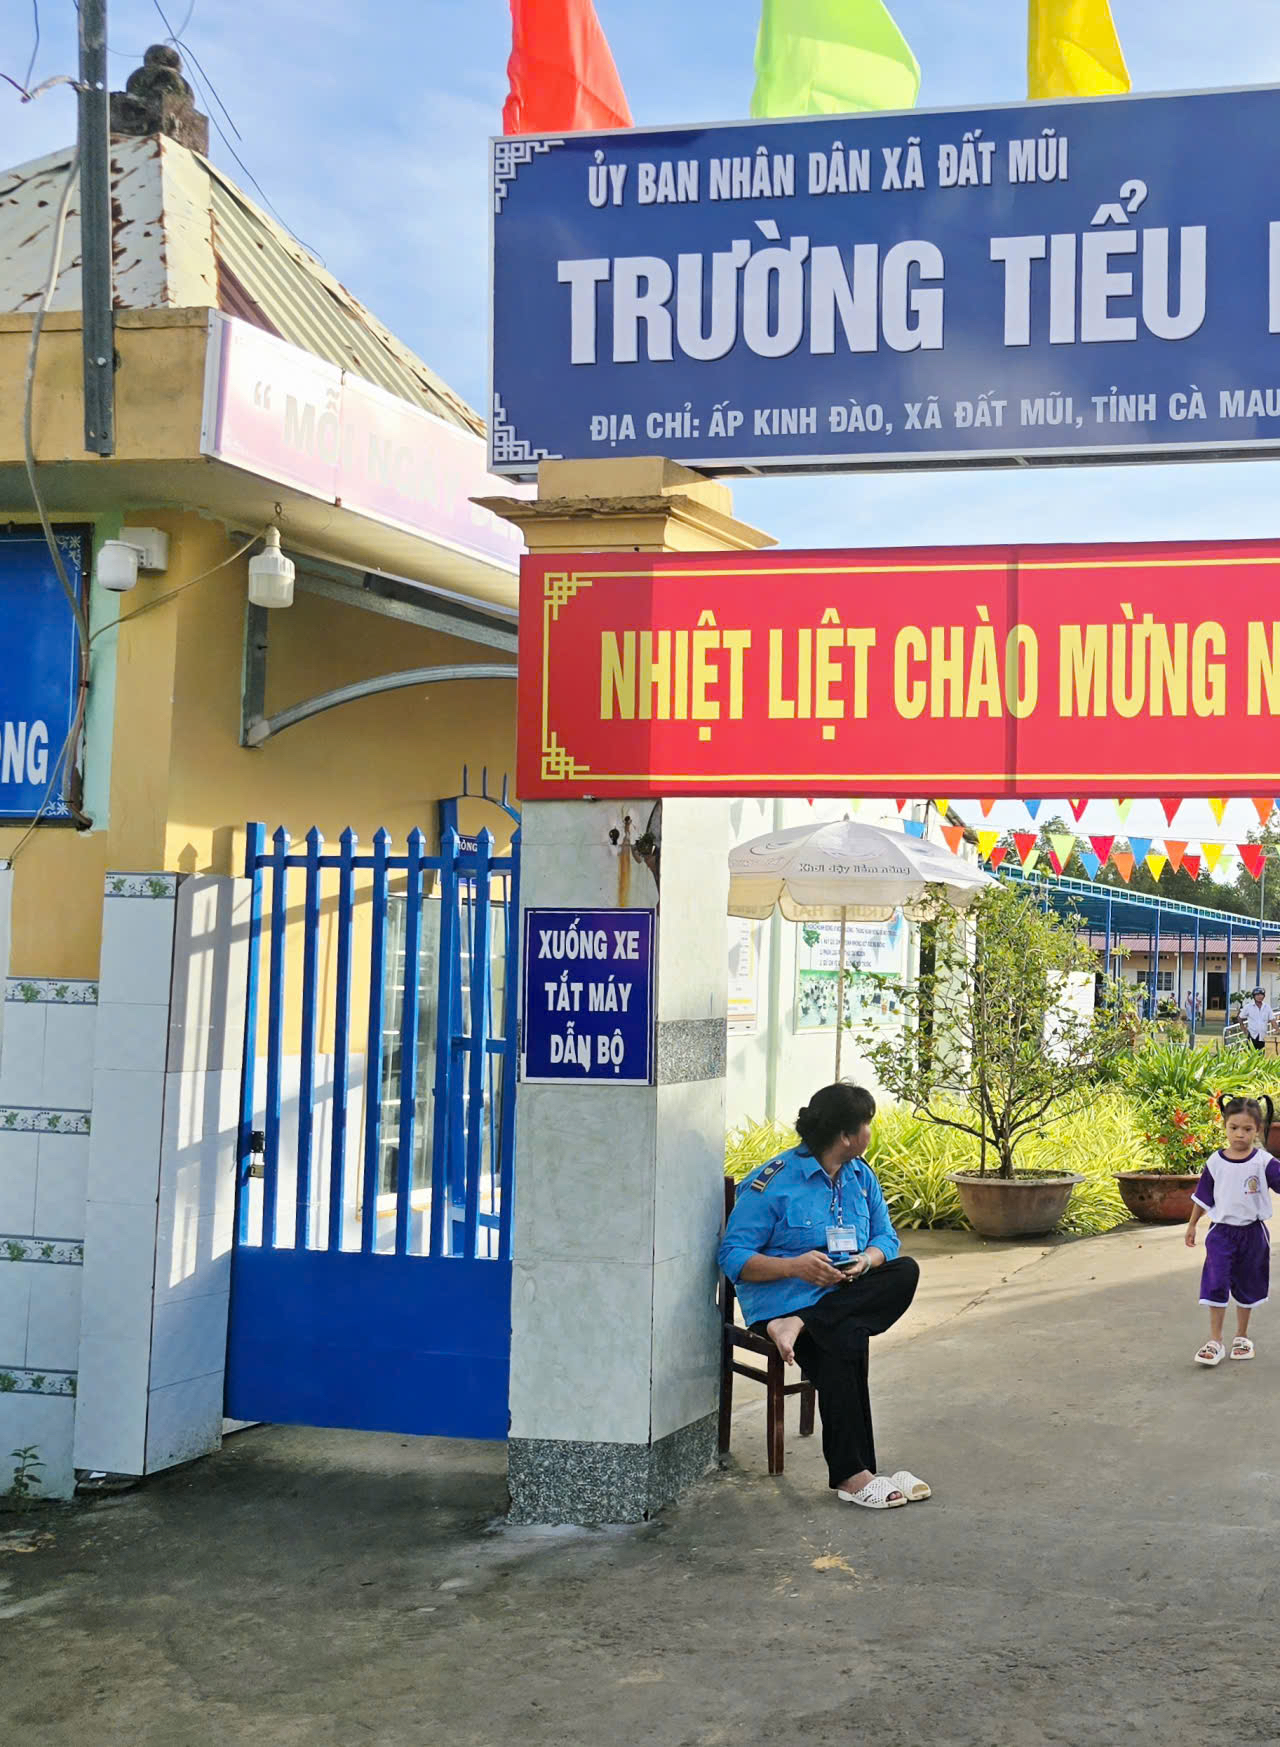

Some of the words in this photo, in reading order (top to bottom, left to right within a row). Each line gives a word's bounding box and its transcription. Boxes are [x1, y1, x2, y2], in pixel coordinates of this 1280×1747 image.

[589, 150, 626, 206] ỦY
[638, 160, 698, 203] BAN
[710, 146, 794, 199] NHÂN
[809, 141, 869, 193] DÂN
[882, 137, 924, 189] XÃ
[938, 129, 995, 186] ĐẤT
[1009, 128, 1067, 182] MŨI
[558, 220, 943, 363] TRƯỜNG
[990, 180, 1206, 345] TIỂU
[590, 415, 636, 440] ĐỊA
[647, 402, 699, 438] CHỈ:
[708, 405, 743, 437] ẤP
[753, 400, 818, 436] KINH
[829, 399, 892, 435] ĐÀO,
[904, 396, 942, 429] XÃ
[954, 391, 1007, 427] ĐẤT
[1021, 392, 1083, 428] MŨI,
[1092, 386, 1156, 423] TỈNH
[1169, 385, 1207, 420] CÀ
[601, 610, 751, 741] NHIỆT
[769, 608, 876, 740] LIỆT
[894, 606, 1038, 719] CHÀO
[1060, 603, 1226, 718] MỪNG
[0, 720, 48, 785] NG
[539, 918, 607, 959] XUỐNG
[613, 931, 639, 959] XE
[545, 970, 583, 1011] TẮT
[589, 975, 632, 1012] MÁY
[551, 1021, 591, 1072] DẪN
[597, 1029, 624, 1073] BỘ
